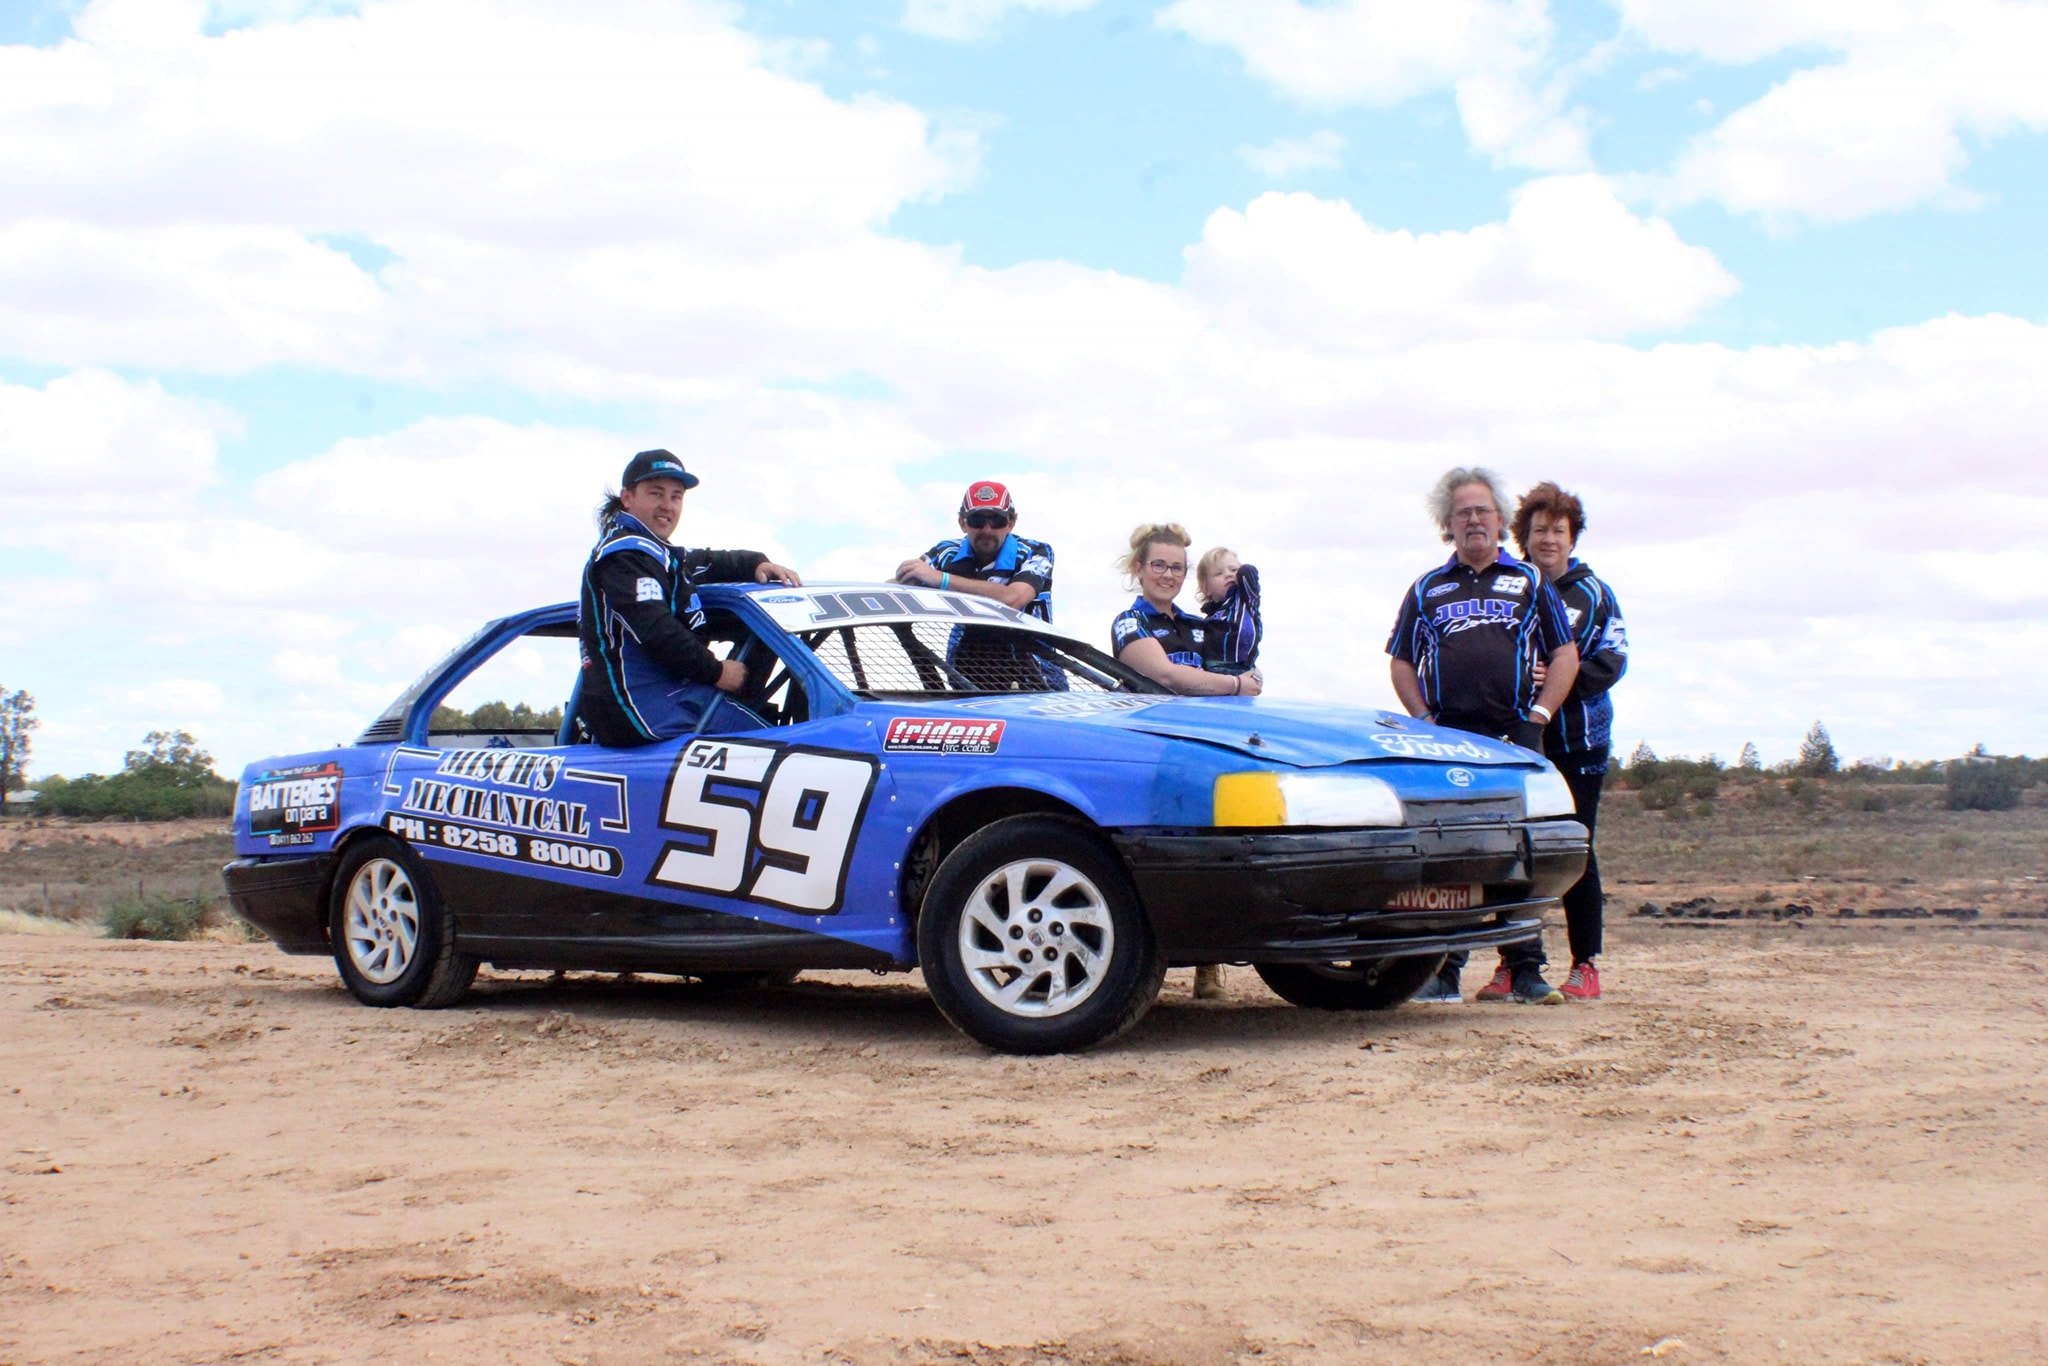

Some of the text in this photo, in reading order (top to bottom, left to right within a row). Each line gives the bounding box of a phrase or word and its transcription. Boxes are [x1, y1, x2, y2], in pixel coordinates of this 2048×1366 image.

[1491, 575, 1528, 596] 59
[807, 590, 1030, 624] JOLLY
[1432, 599, 1520, 626] JOLLY
[1167, 651, 1203, 667] OLL
[891, 721, 998, 745] trident
[1370, 733, 1490, 759] Ford
[687, 744, 728, 771] SA
[942, 743, 991, 756] tyre centre
[436, 749, 565, 791] MISCH'S
[250, 776, 338, 811] BATTERIES
[285, 806, 327, 828] on para
[402, 778, 590, 838] MECHANICAL
[648, 738, 877, 913] 59
[442, 825, 518, 856] 8258
[530, 840, 611, 871] 8000
